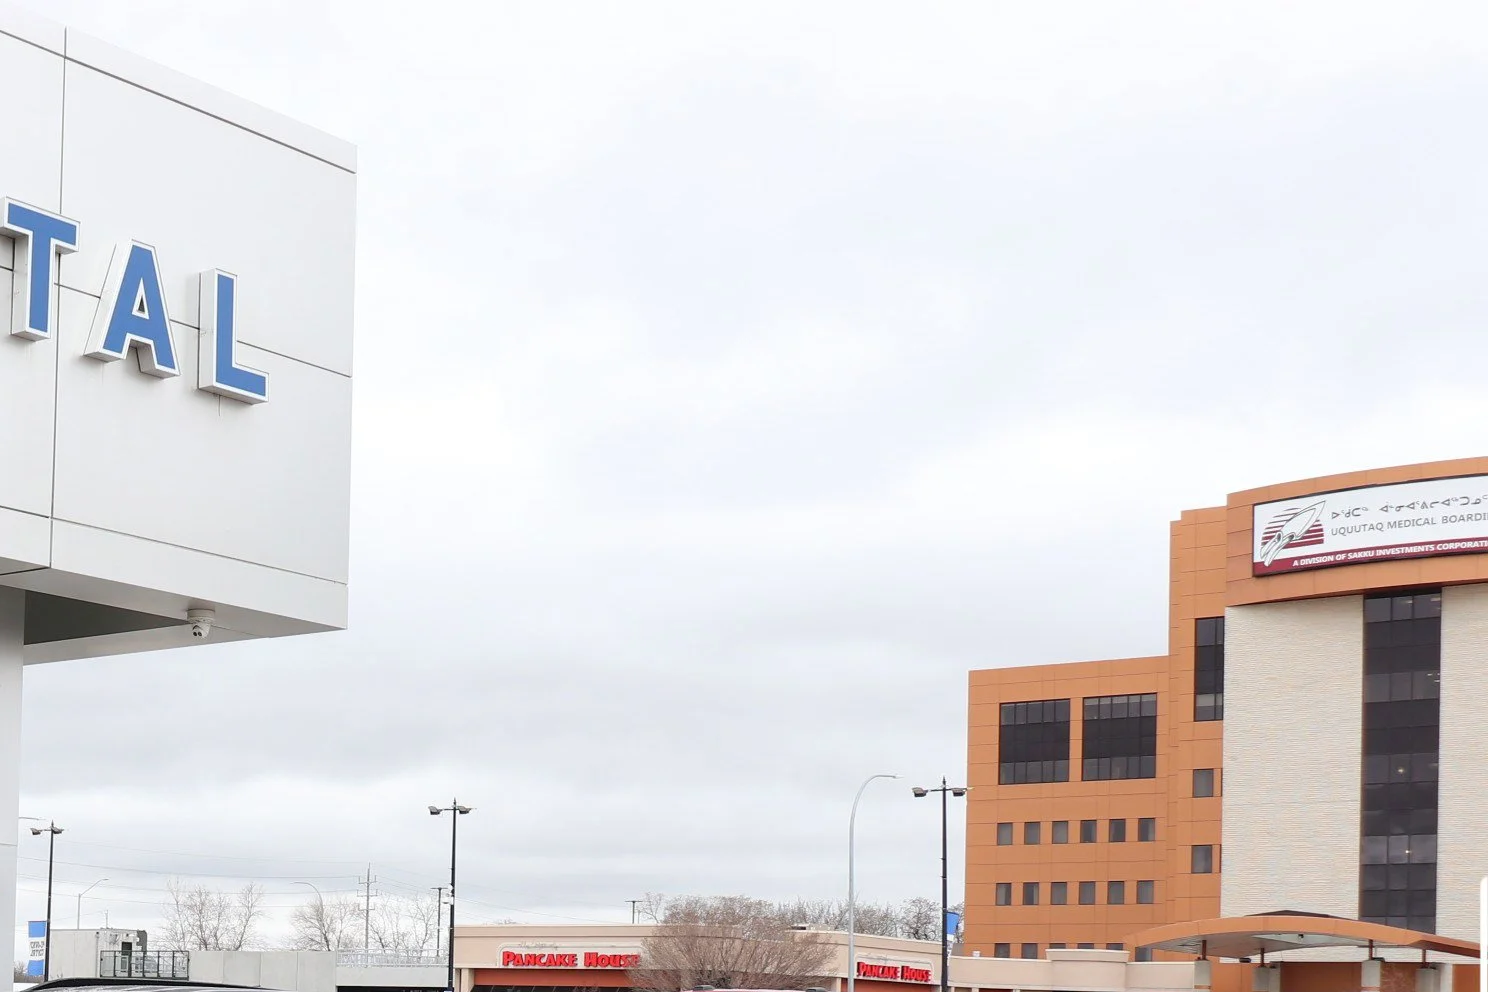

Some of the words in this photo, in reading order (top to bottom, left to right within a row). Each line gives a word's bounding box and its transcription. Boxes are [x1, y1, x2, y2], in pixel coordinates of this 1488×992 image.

[1331, 522, 1384, 537] UQUUTAQ
[1387, 516, 1437, 530] MEDICAL
[1441, 512, 1488, 524] BOARDI
[1300, 556, 1334, 566] DIVISION
[1335, 553, 1347, 561] OF
[1348, 550, 1375, 560] SAKKU
[1375, 545, 1435, 556] INVESTMENTS
[502, 951, 578, 967] PANCAKE
